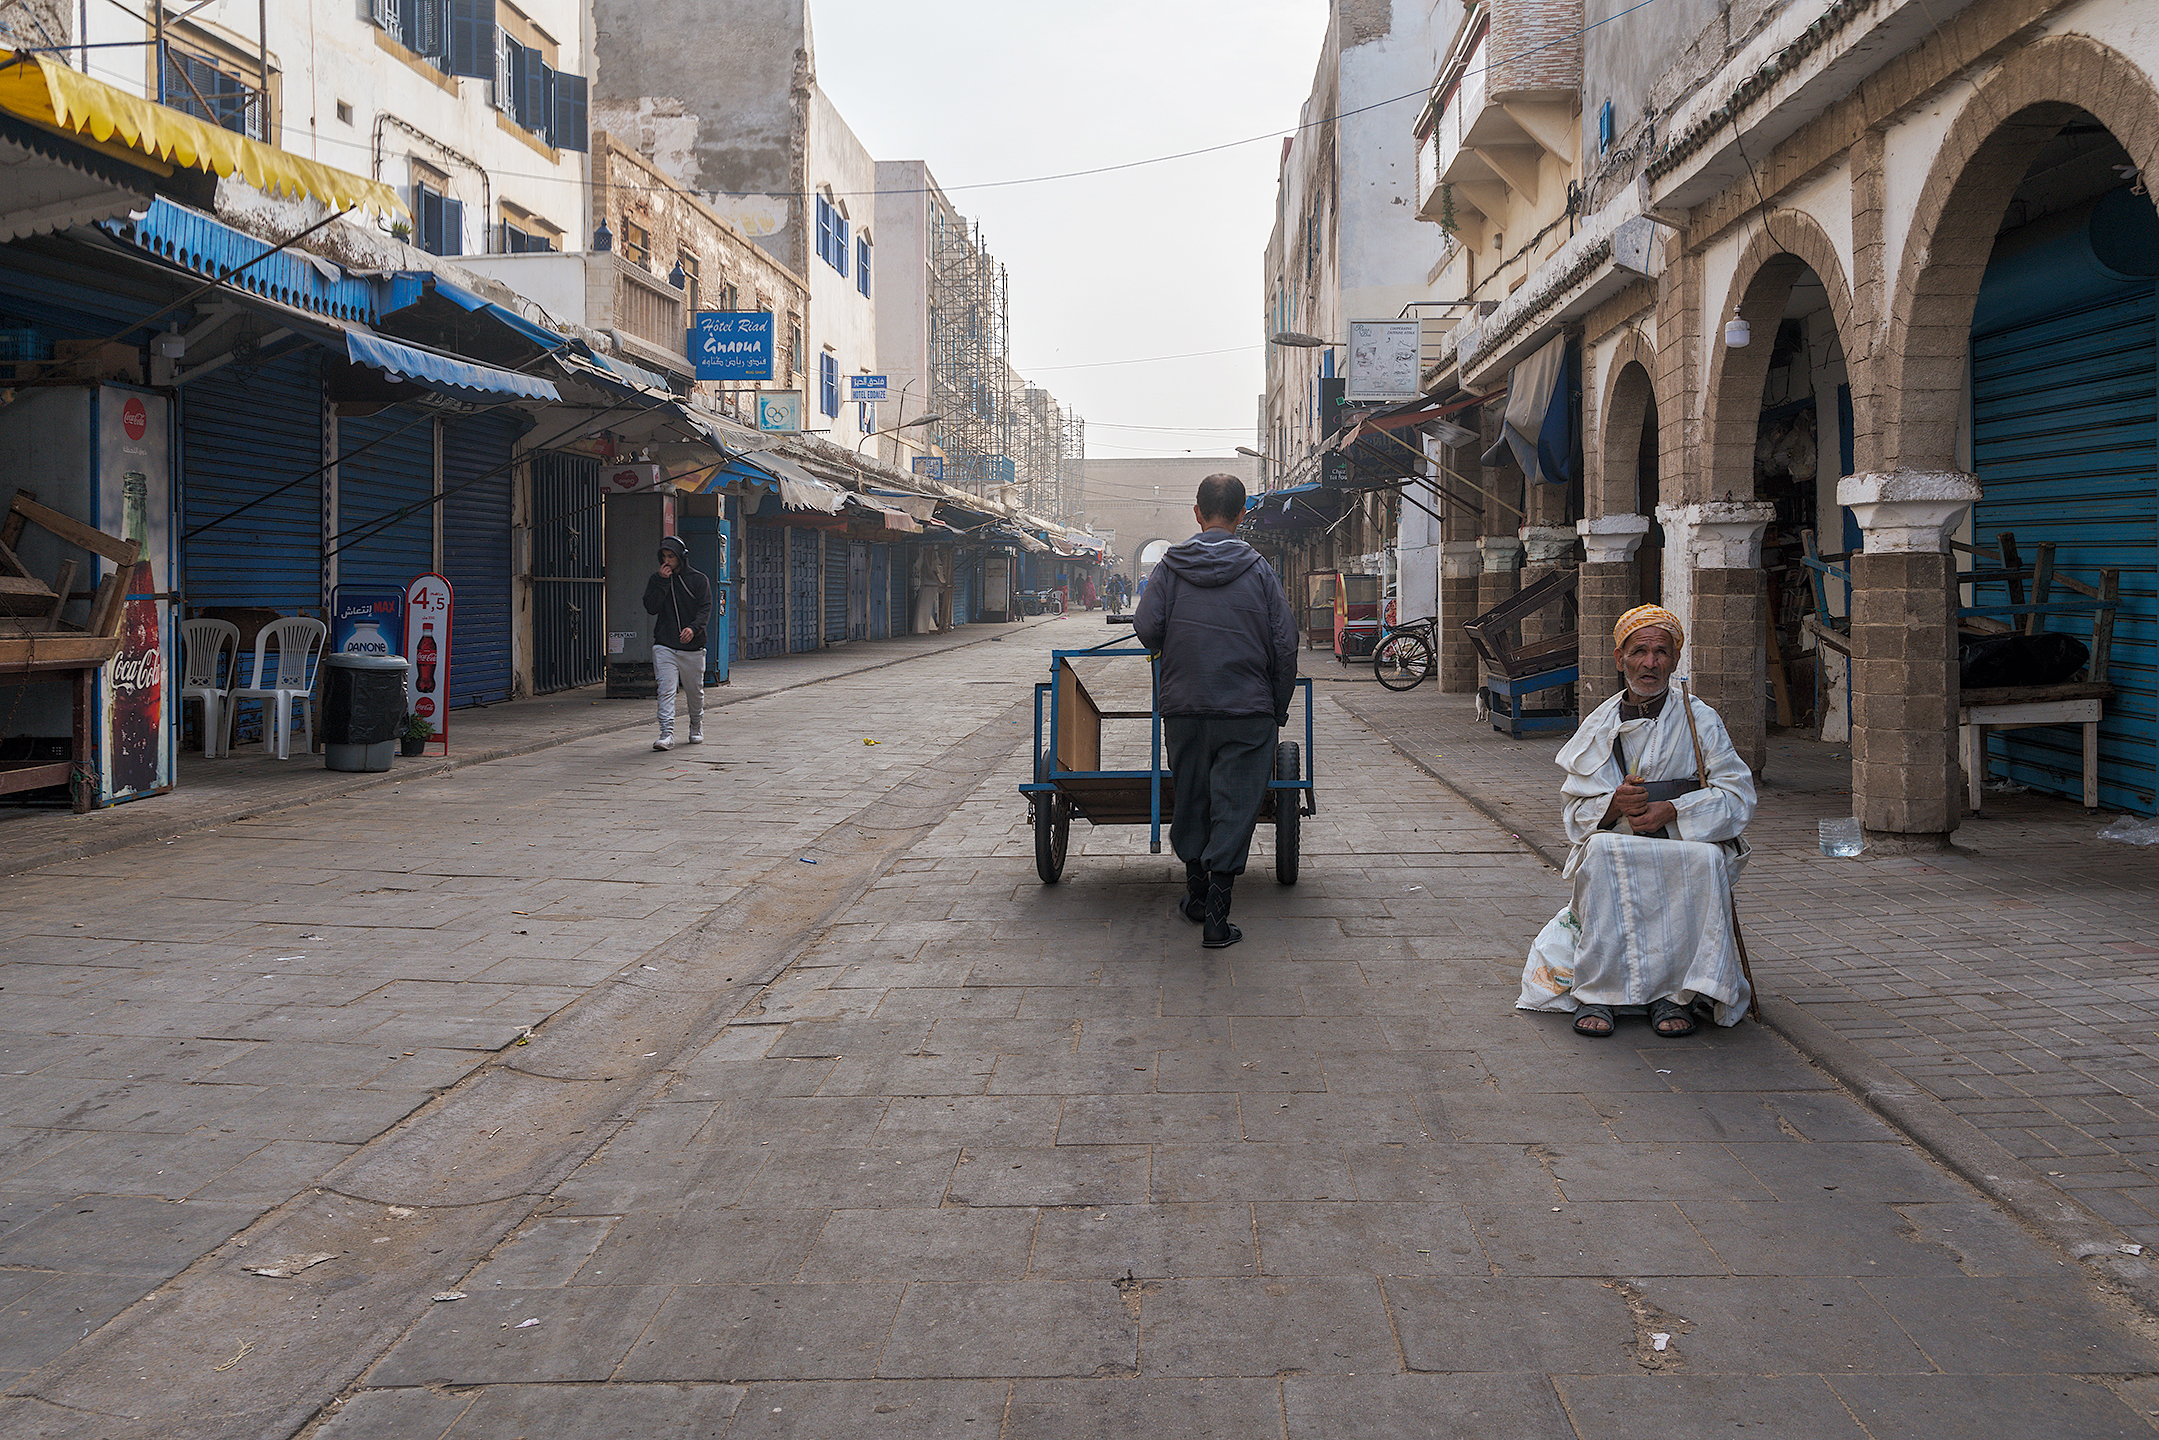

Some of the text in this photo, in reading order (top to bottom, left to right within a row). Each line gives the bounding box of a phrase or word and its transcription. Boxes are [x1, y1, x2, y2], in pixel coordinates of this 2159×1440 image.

[701, 318, 769, 333] Hôtel Riad
[724, 356, 745, 368] رياض
[746, 356, 767, 368] فندق
[852, 390, 866, 399] HOTEL
[340, 600, 396, 619] MAX إنتعاش
[347, 642, 386, 652] DANONE
